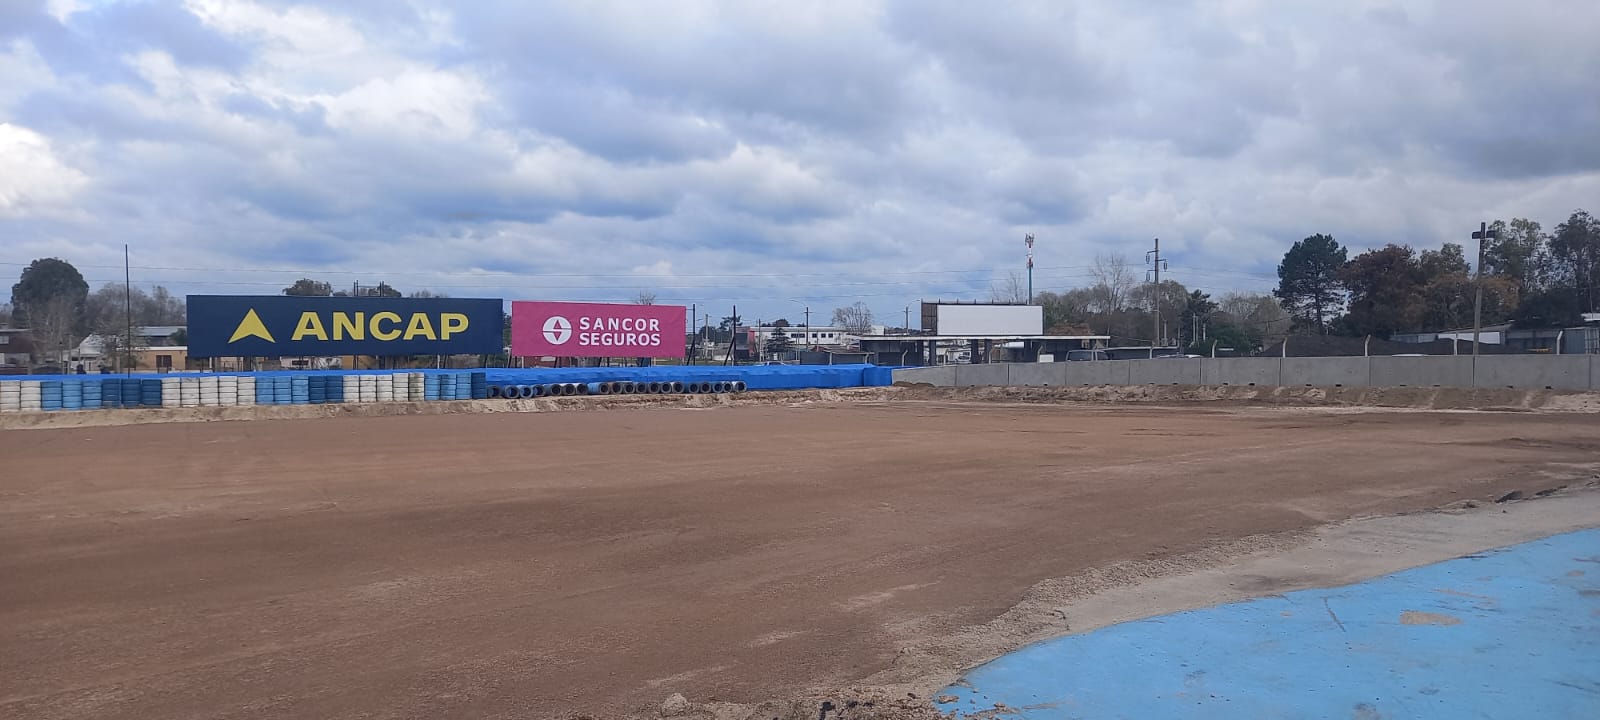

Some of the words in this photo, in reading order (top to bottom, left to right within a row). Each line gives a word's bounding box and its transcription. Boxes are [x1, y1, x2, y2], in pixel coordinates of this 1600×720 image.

[291, 311, 469, 341] ANCAP
[579, 316, 660, 332] SANCOR
[579, 332, 661, 346] SEGUROS
